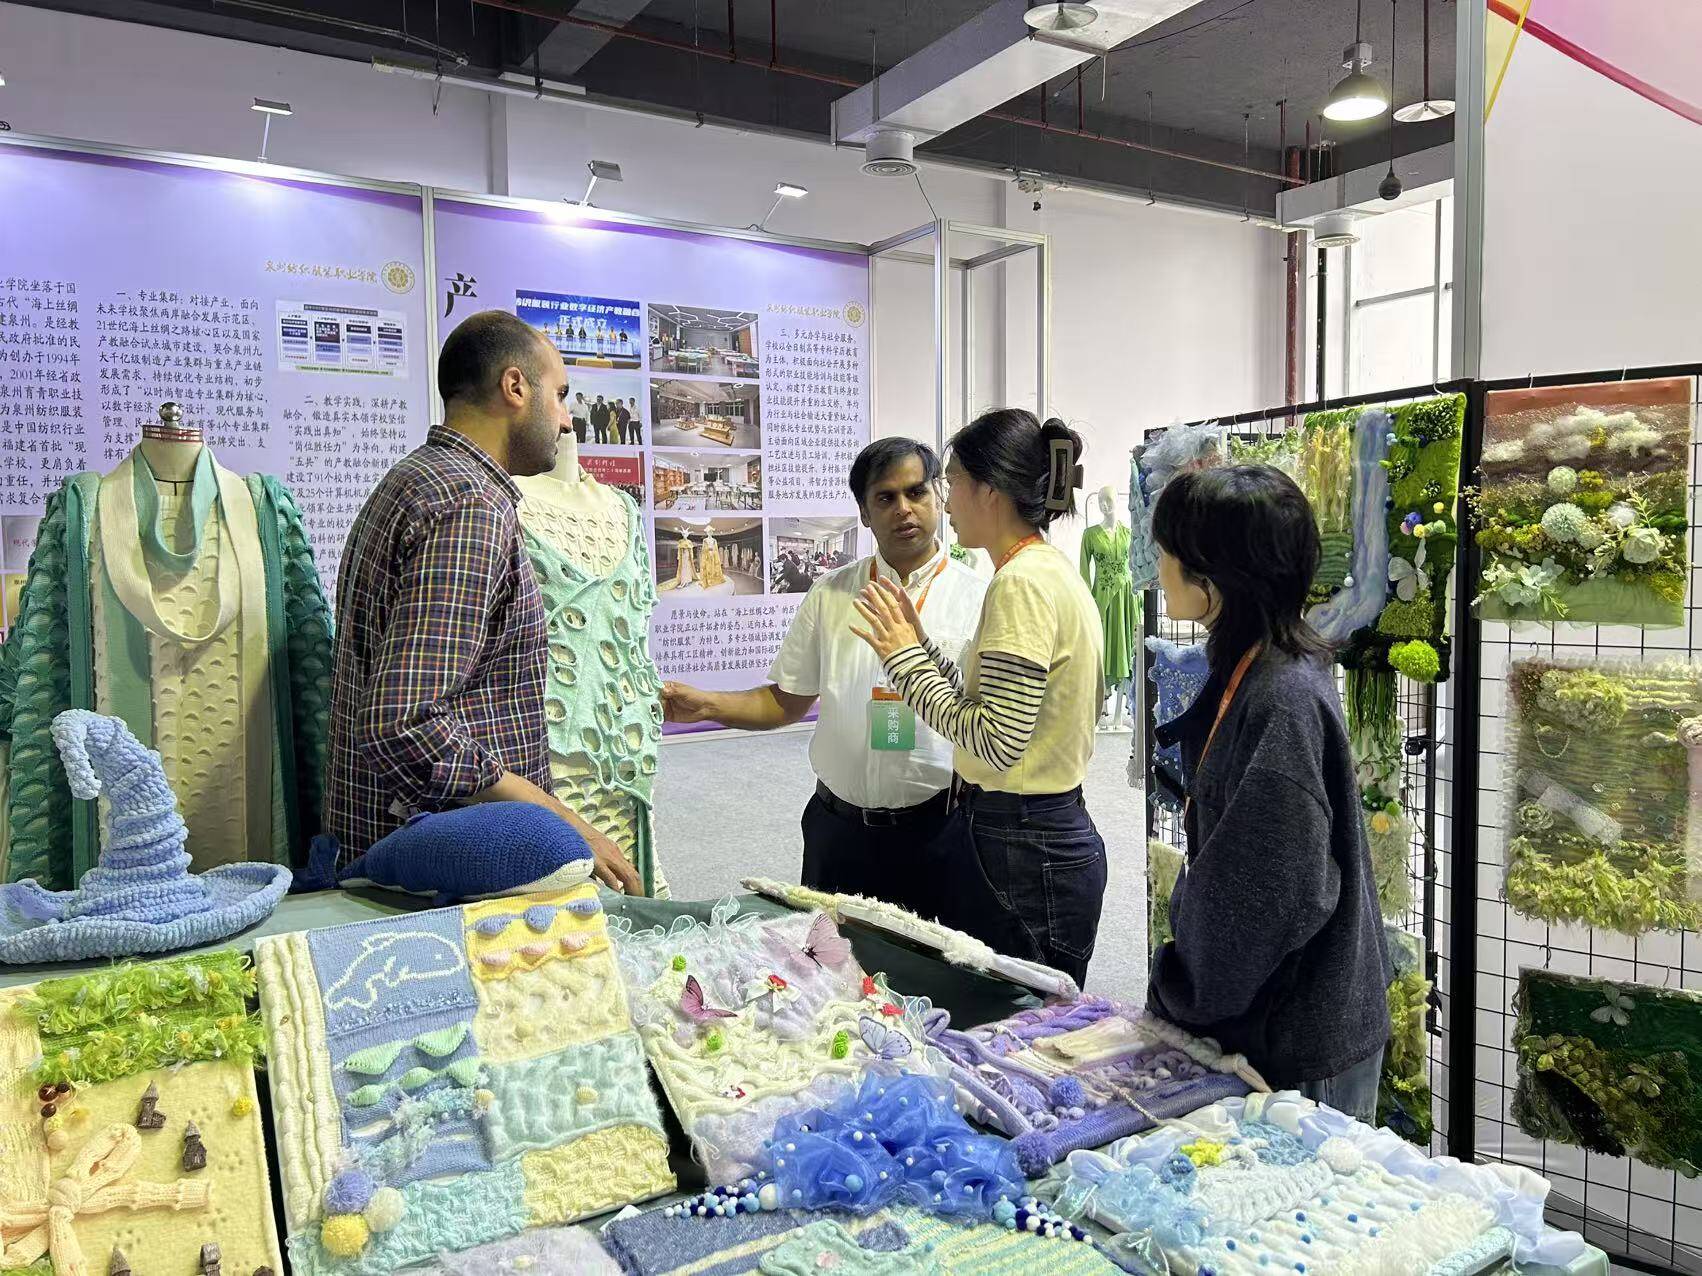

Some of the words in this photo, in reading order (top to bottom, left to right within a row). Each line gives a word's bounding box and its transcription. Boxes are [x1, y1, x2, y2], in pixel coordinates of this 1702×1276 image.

[445, 272, 478, 318] 产
[0, 456, 87, 471] 学校，更肩负着
[104, 448, 131, 460] 撑有
[887, 706, 899, 744] 采购商
